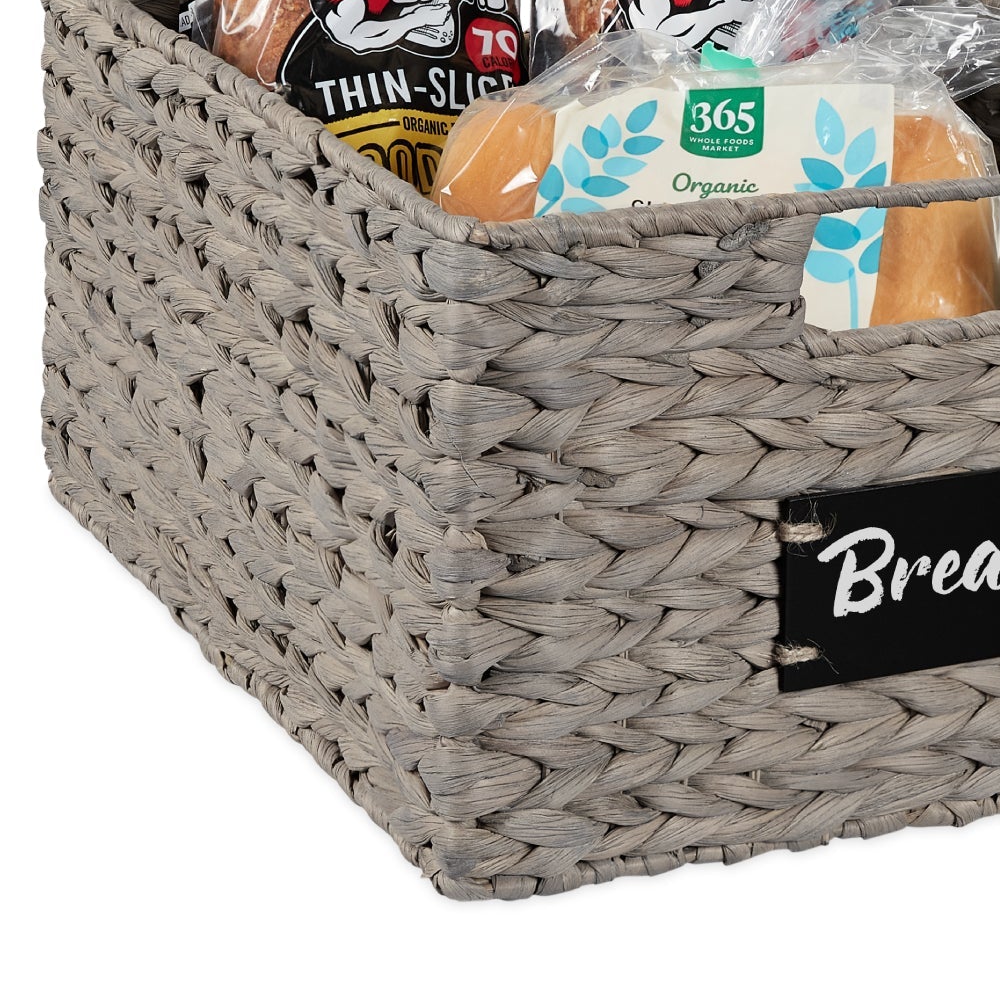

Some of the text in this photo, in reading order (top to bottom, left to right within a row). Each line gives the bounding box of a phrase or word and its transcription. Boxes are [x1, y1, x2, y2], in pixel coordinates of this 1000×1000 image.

[472, 26, 518, 60] 70
[403, 116, 449, 135] ORGANIC
[690, 98, 755, 134] 365
[690, 136, 754, 146] WHOLE FOODS
[672, 172, 759, 199] Organic
